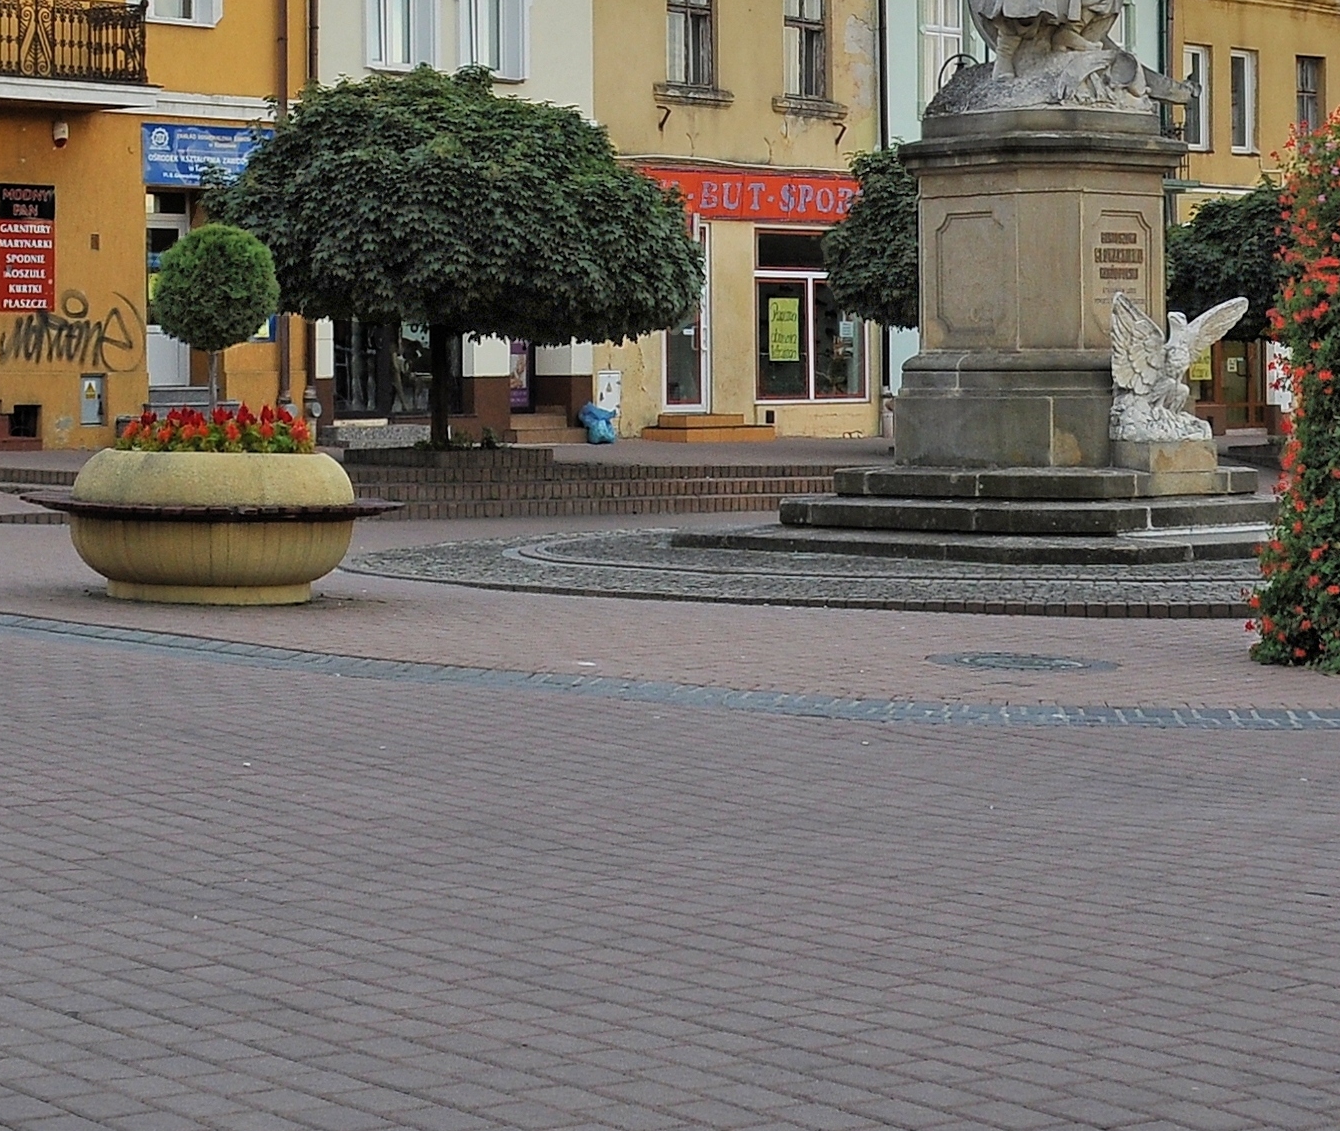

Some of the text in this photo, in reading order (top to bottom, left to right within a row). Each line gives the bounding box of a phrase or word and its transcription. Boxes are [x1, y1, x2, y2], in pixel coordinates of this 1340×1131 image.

[1, 188, 53, 203] MODNY
[778, 182, 860, 215] SPOR
[12, 203, 39, 217] PAN
[0, 223, 51, 234] GARNITURY
[5, 253, 46, 264] SPODNIE
[3, 268, 46, 279] KOSZULE
[8, 283, 42, 294] KURTKI
[2, 298, 48, 309] PŁASZCZE
